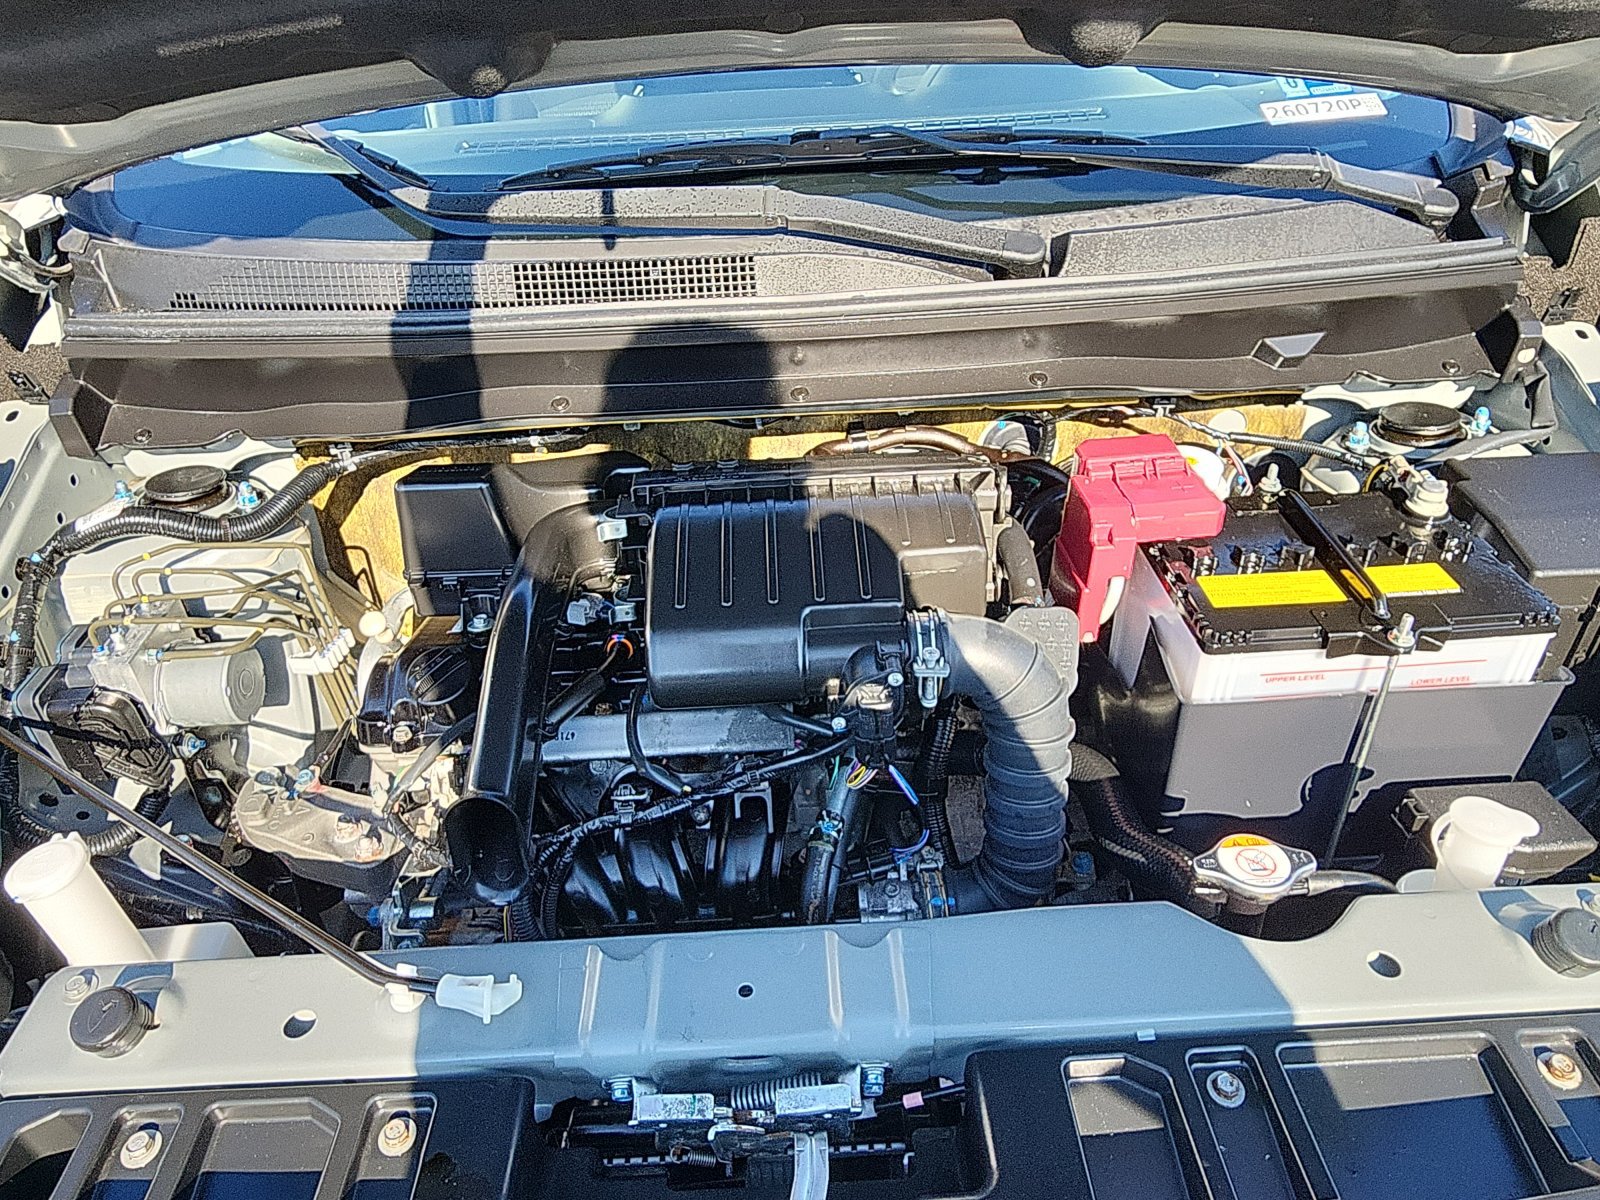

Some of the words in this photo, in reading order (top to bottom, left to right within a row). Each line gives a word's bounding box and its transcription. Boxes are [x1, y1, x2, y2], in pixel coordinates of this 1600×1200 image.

[1265, 675, 1296, 684] UPPER
[1298, 674, 1326, 682] LEVEL
[1410, 677, 1443, 686] LOWER
[1445, 675, 1471, 684] LEVEL
